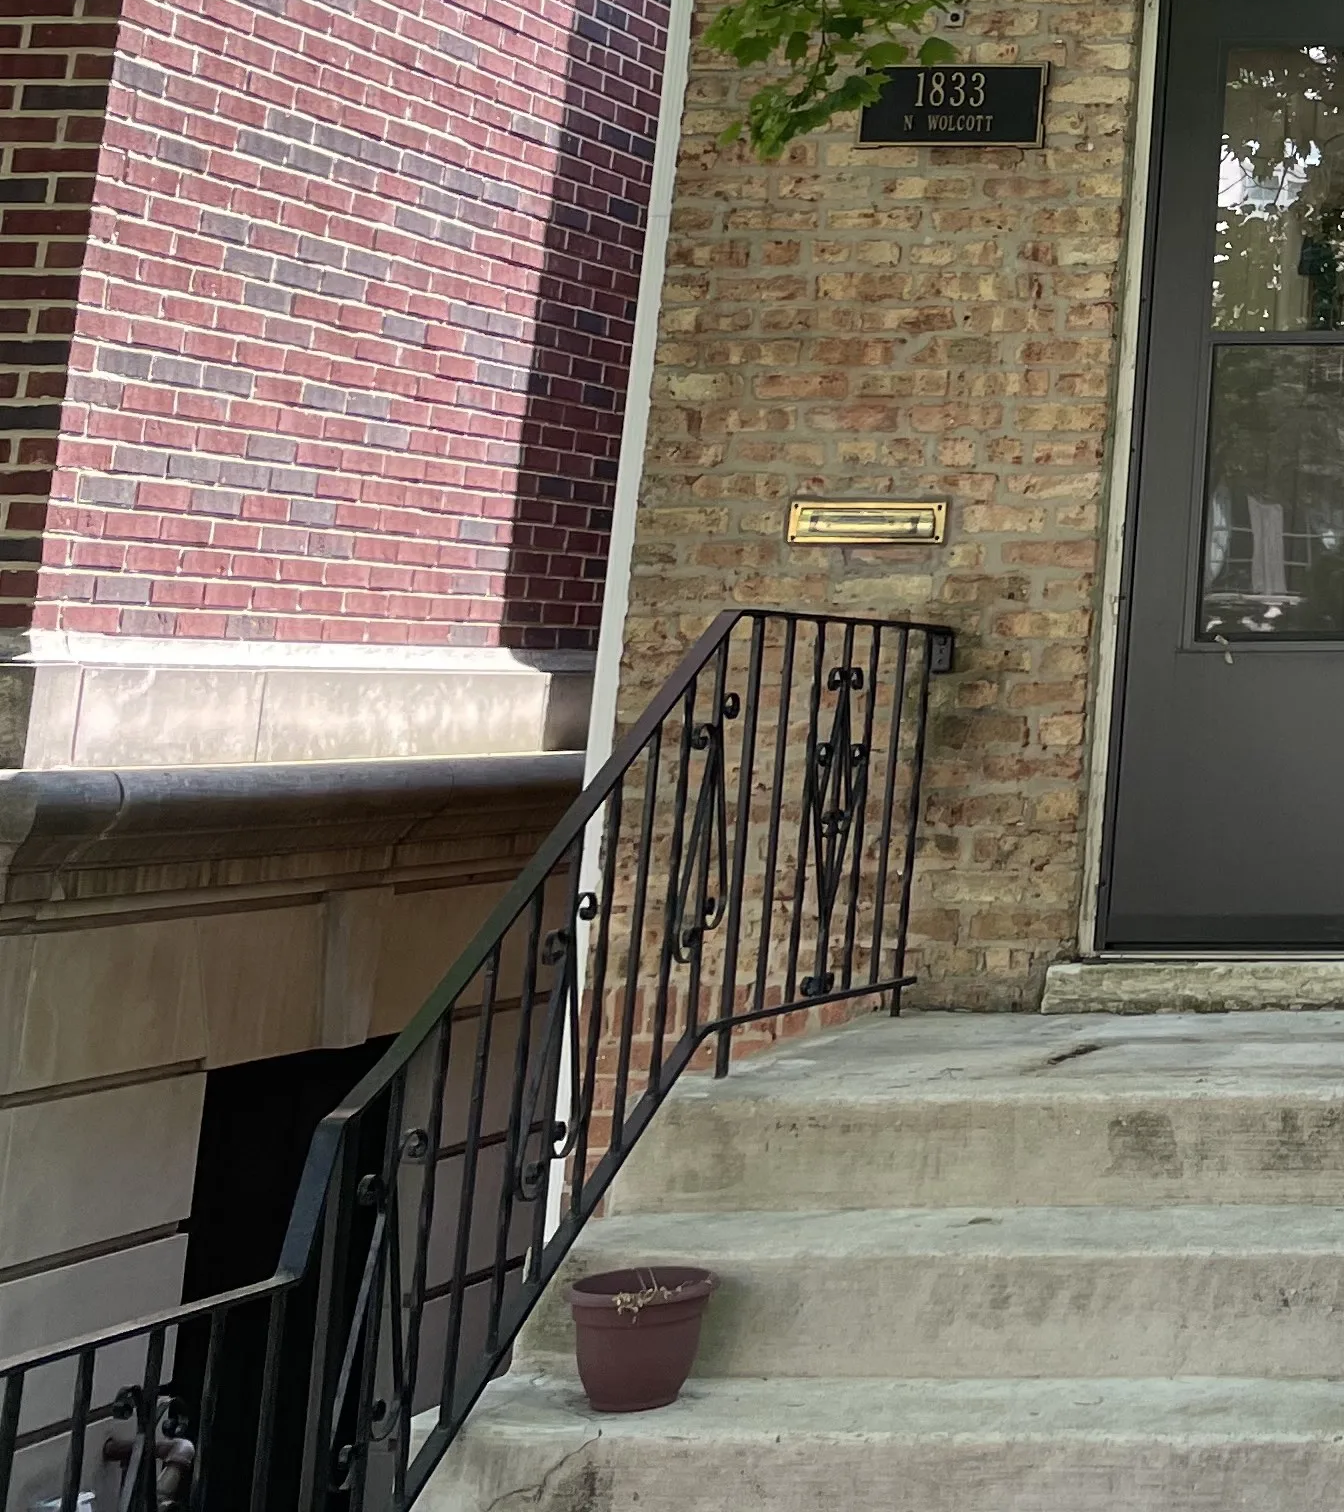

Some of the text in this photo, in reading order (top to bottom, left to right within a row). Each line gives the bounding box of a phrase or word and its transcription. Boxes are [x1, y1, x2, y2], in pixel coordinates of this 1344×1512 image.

[914, 71, 986, 108] 1833
[903, 114, 994, 133] N WOLCOTT
